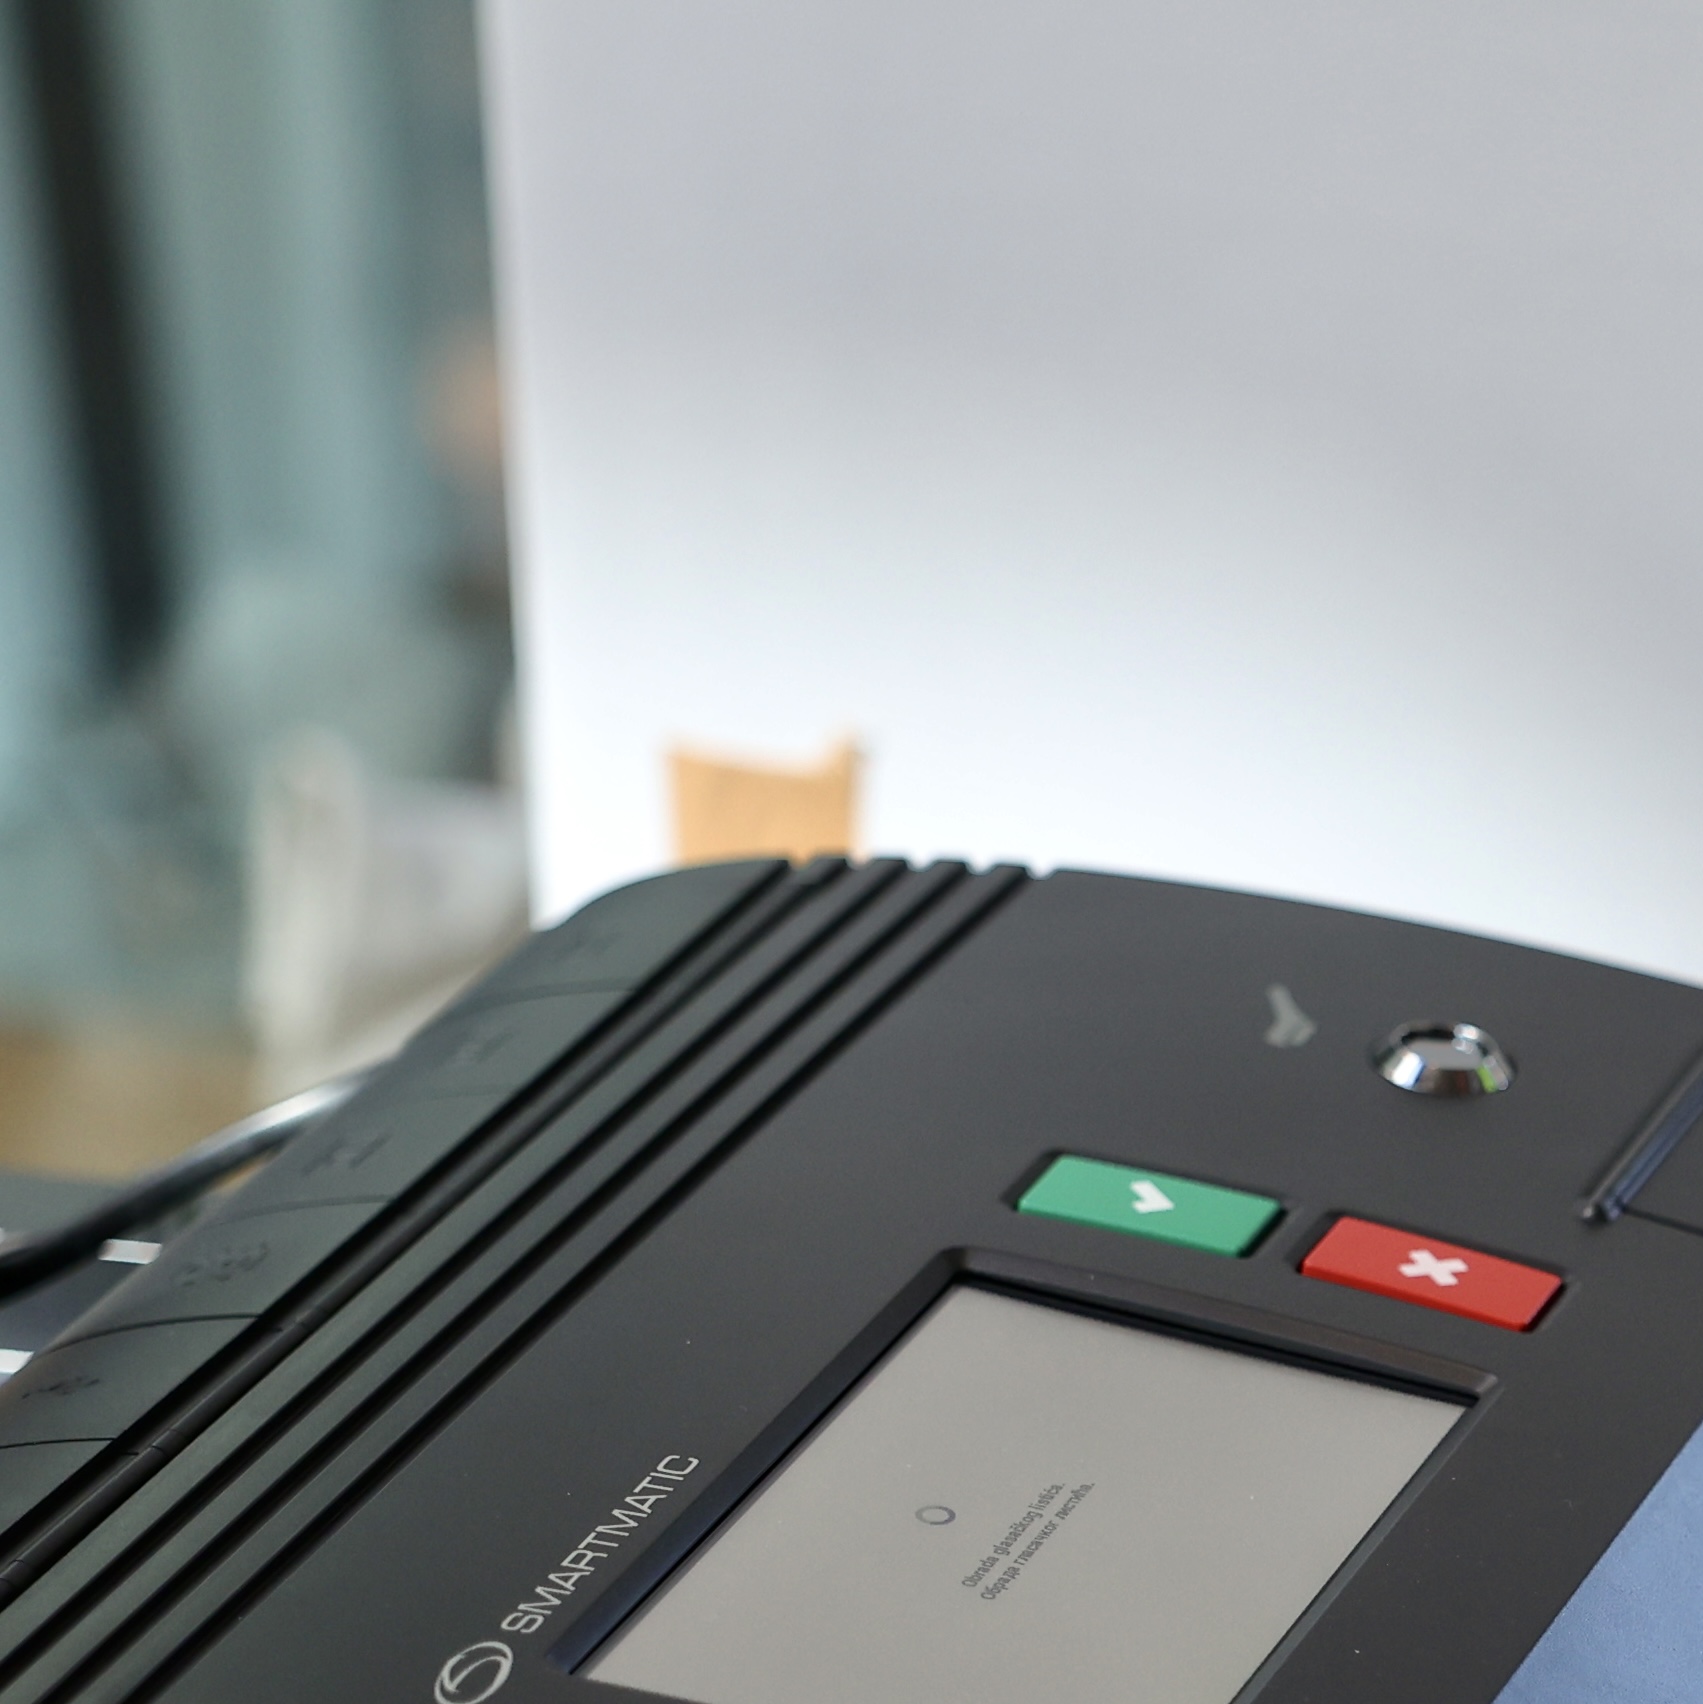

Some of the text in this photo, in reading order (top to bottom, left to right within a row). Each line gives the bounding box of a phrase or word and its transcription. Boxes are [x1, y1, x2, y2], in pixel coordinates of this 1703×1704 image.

[501, 1455, 699, 1633] SMARTMATIC
[962, 1556, 999, 1587] Obrada
[980, 1566, 1020, 1600] Обрада
